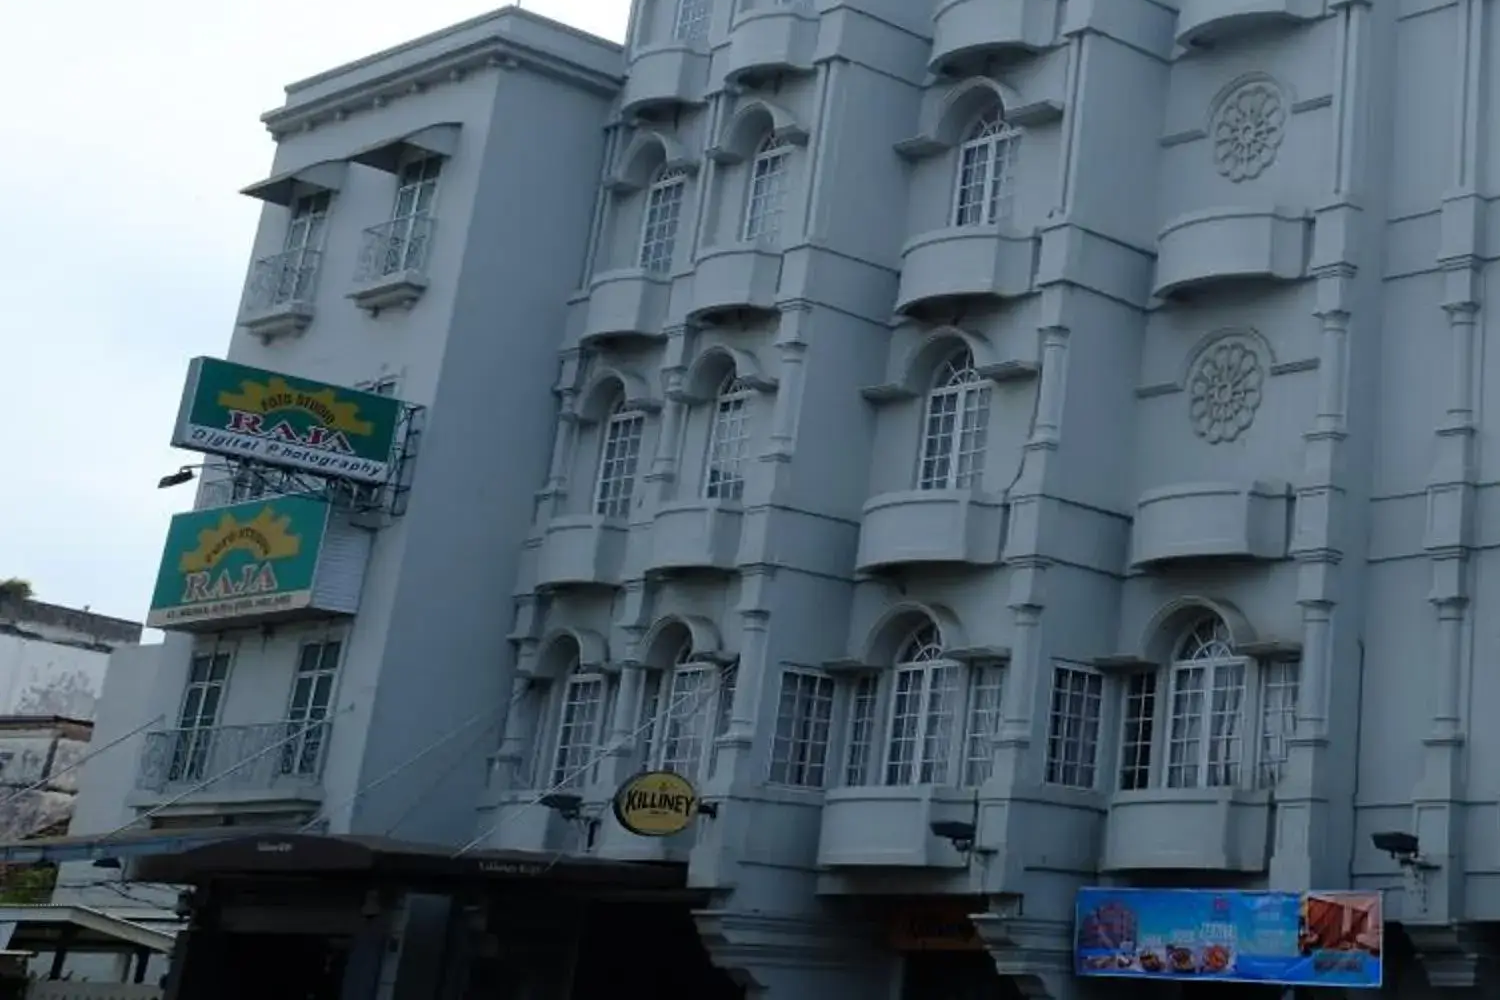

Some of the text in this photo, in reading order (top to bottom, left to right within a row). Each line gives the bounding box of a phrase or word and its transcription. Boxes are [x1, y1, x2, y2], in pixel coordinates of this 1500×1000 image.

[191, 427, 385, 477] Digital Photography
[225, 410, 356, 455] RAJA
[182, 561, 278, 603] RAJA
[625, 789, 695, 817] KILLINEY
